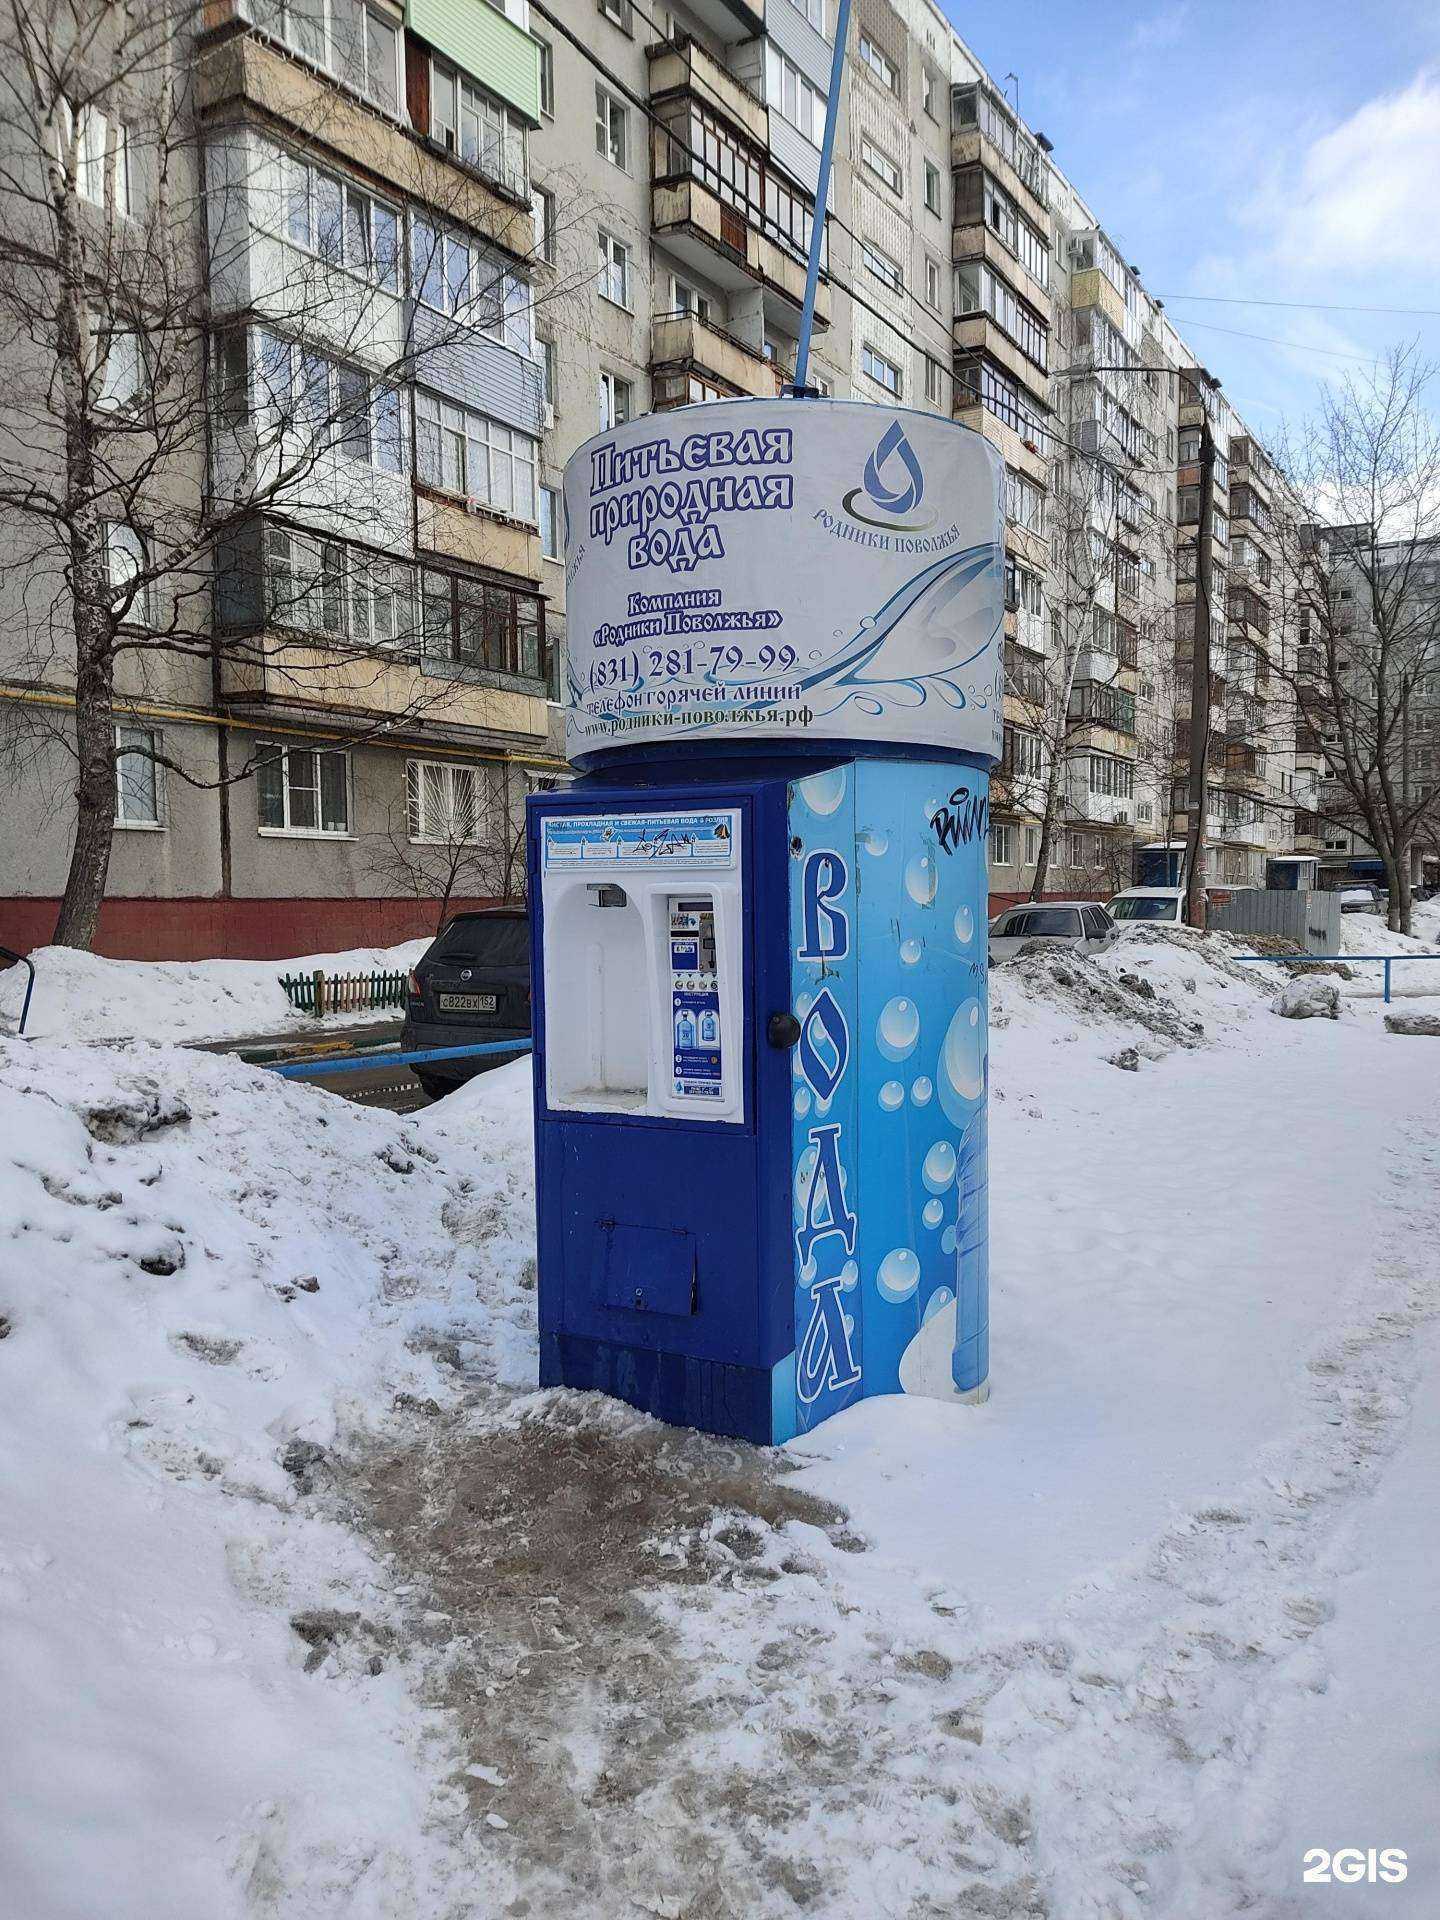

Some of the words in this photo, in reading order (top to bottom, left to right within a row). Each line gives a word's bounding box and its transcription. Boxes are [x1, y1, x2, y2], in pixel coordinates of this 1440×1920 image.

[590, 429, 793, 496] Питьевая
[590, 474, 793, 545] природная
[628, 524, 725, 573] вода
[628, 589, 721, 616] Компания
[664, 610, 783, 635] Поволжья»
[589, 651, 639, 692] (831)
[649, 645, 797, 677] 281-79-99
[586, 692, 643, 717] телефон
[647, 682, 725, 710] горячей
[734, 685, 801, 702] линии
[583, 705, 814, 736] www.родники-поволжья.рф
